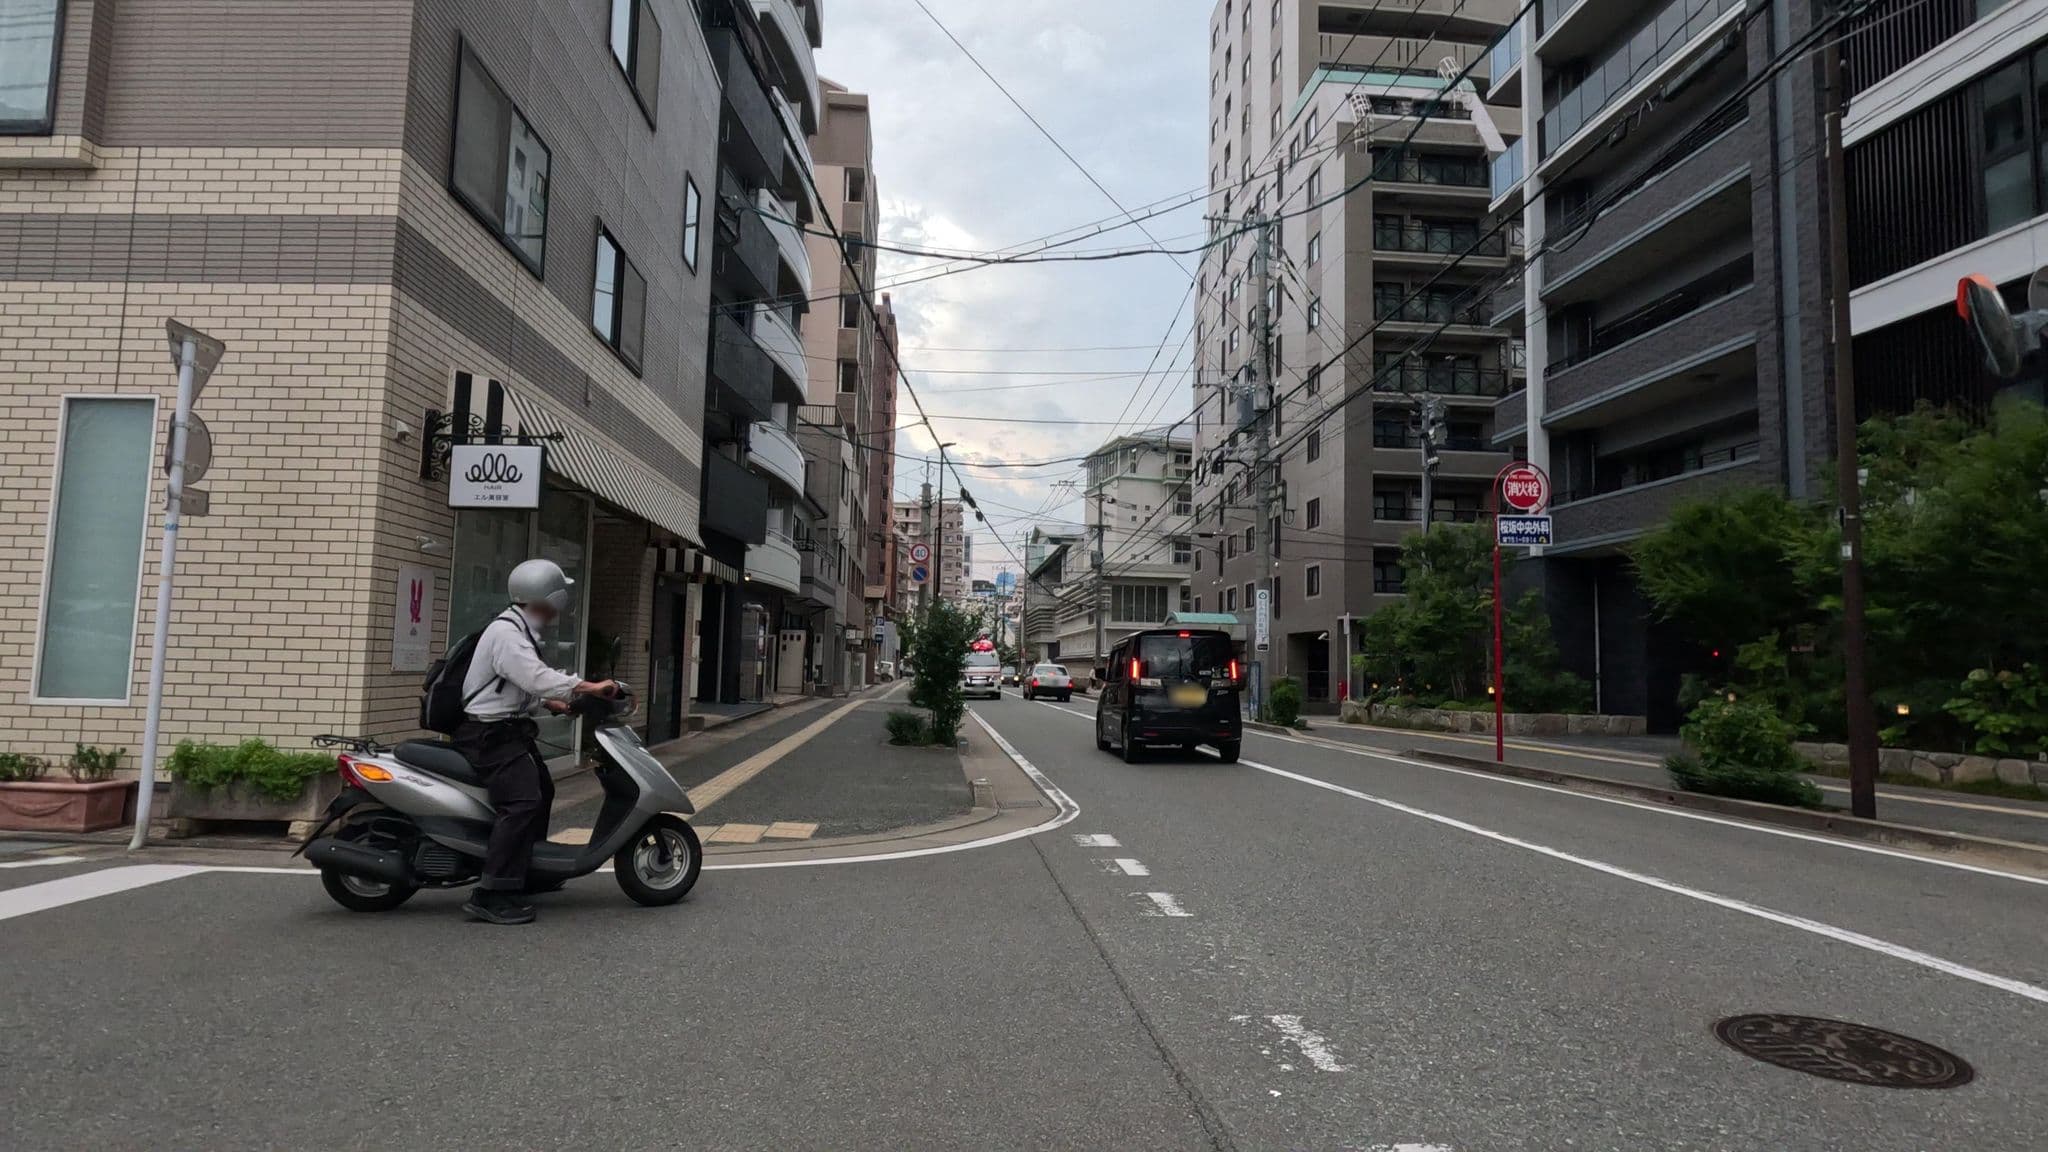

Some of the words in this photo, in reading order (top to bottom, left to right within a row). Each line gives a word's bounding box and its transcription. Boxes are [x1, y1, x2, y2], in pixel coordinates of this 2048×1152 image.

[465, 452, 523, 483] elle
[1507, 481, 1540, 497] 消火栓
[914, 548, 927, 558] 40
